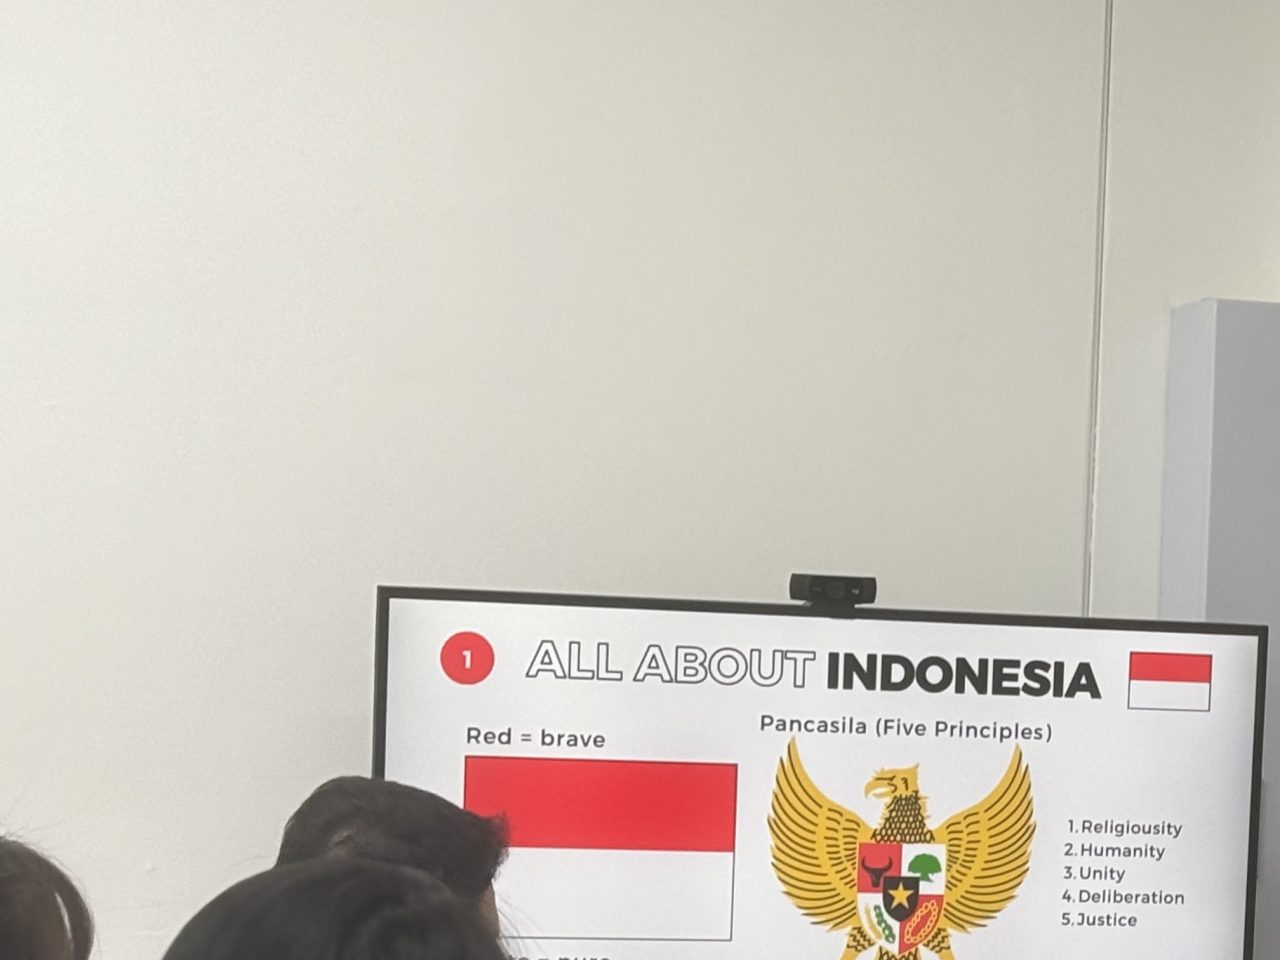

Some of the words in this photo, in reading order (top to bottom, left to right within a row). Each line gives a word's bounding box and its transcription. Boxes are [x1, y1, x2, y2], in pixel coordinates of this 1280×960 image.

[461, 649, 474, 670] 1
[525, 640, 623, 681] ALL
[632, 644, 816, 688] ABOUT
[827, 652, 1102, 699] INDONESIA
[467, 727, 511, 745] Red
[541, 729, 605, 748] brave
[761, 715, 866, 734] Pancasila
[876, 718, 926, 737] (Five
[935, 720, 1051, 742] Principles)
